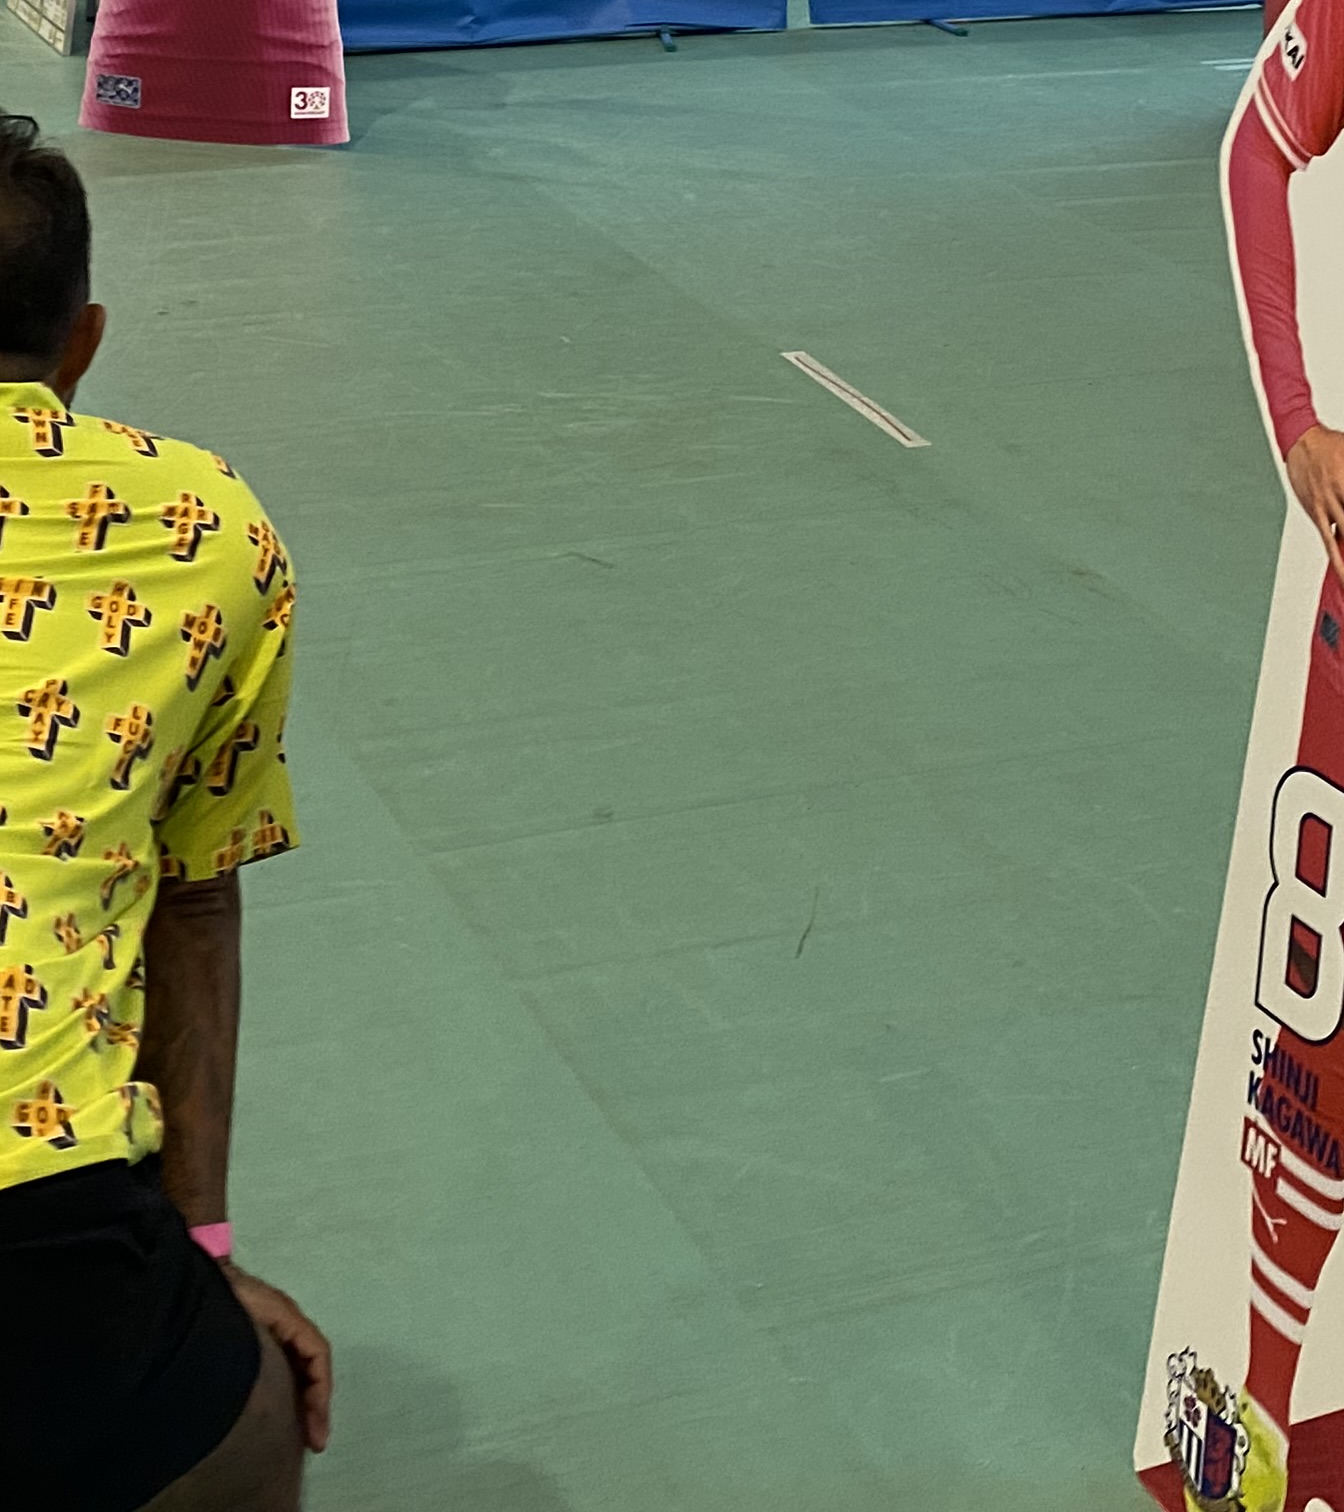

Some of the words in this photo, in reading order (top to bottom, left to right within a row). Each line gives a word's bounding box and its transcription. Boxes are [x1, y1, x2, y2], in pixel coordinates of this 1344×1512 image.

[1251, 1029, 1318, 1111] SHINJI
[1244, 1127, 1277, 1178] MF
[1248, 1070, 1343, 1178] KAGAWA
